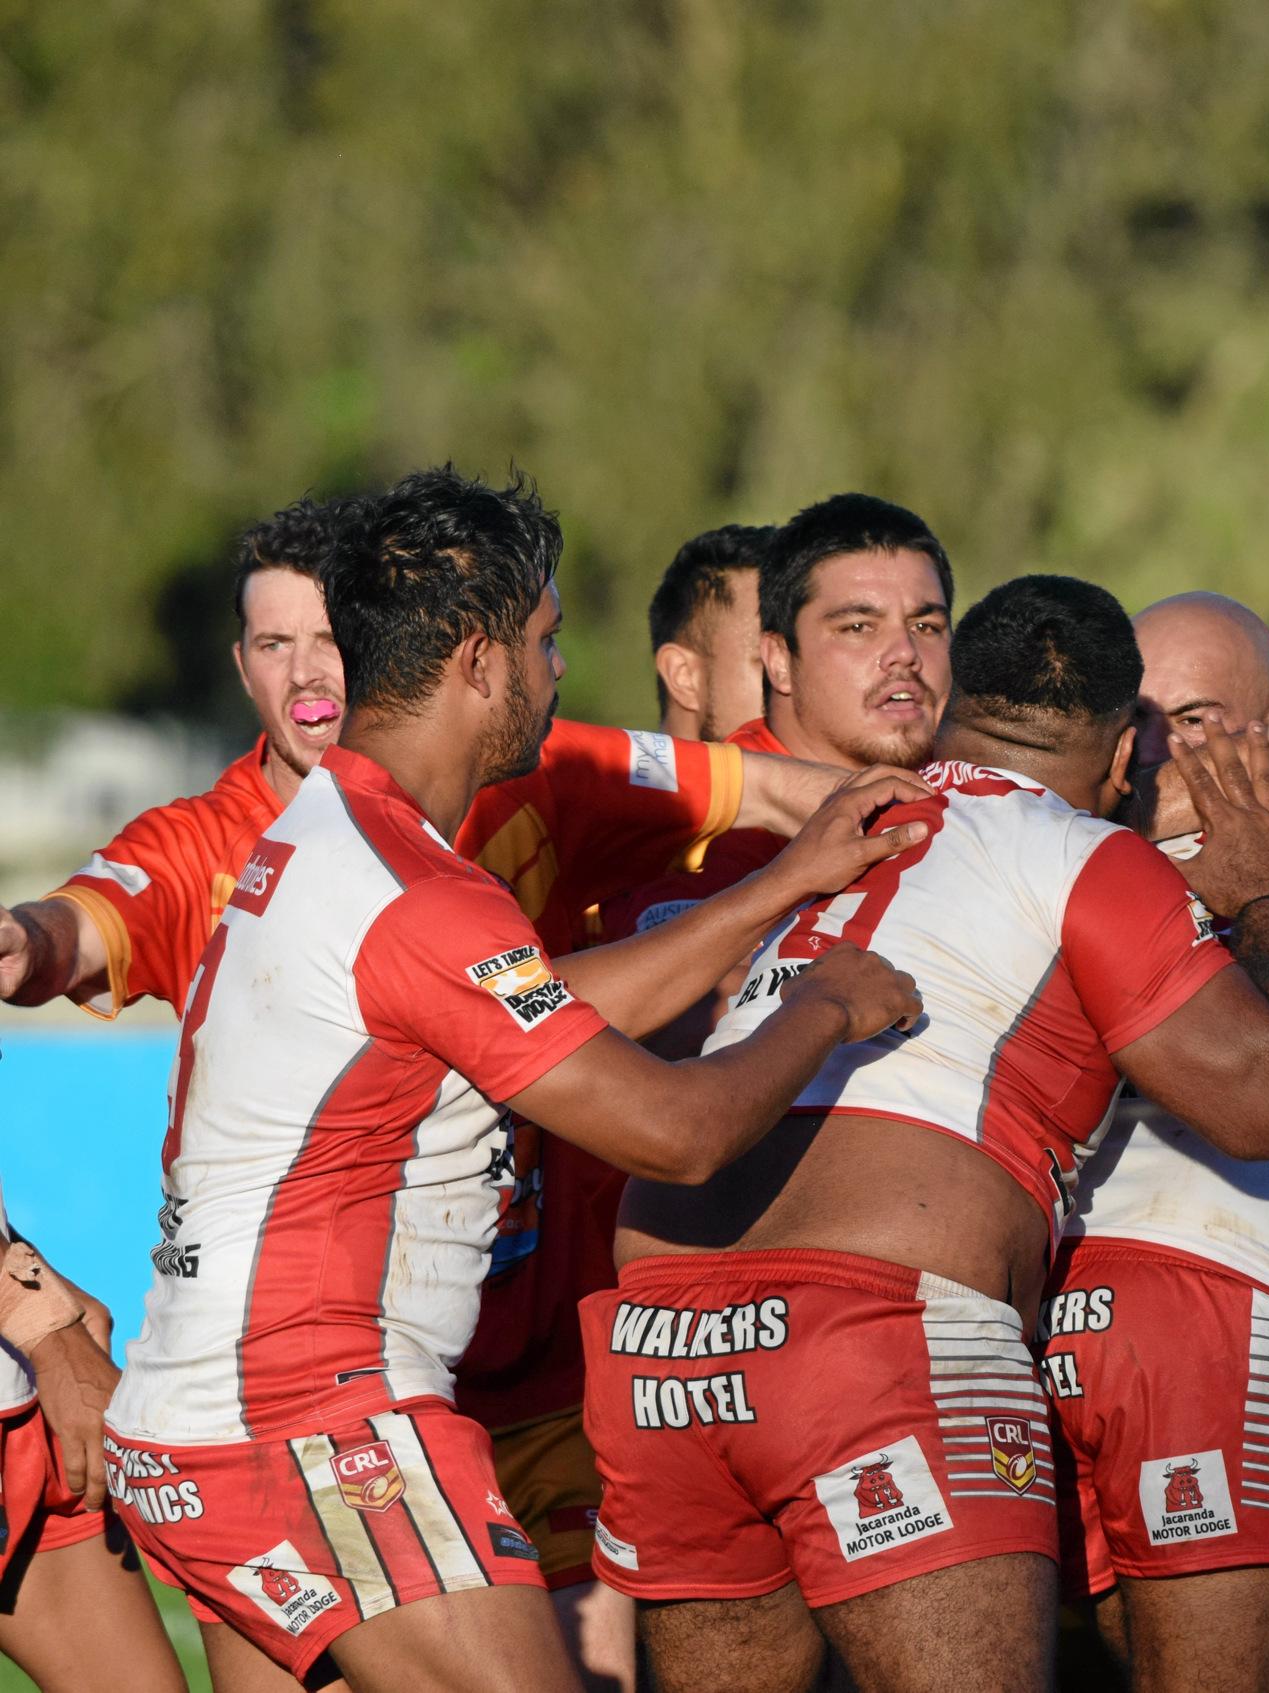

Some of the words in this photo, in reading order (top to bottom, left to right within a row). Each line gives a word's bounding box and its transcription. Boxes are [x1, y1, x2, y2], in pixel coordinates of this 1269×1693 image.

[471, 958, 503, 979] LET'S
[500, 945, 535, 966] TACKLE
[609, 1296, 789, 1361] WALKERS
[1041, 1351, 1085, 1398] EL
[632, 1370, 757, 1430] HOTEL
[993, 1422, 1029, 1446] CRL
[338, 1449, 389, 1477] CRL
[846, 1529, 896, 1555] MOTOR
[899, 1512, 944, 1538] LODGE
[856, 1504, 921, 1537] Jacaranda
[1151, 1526, 1192, 1542] MOTOR
[1195, 1518, 1232, 1535] LODGE
[1161, 1508, 1215, 1528] Jacaranda
